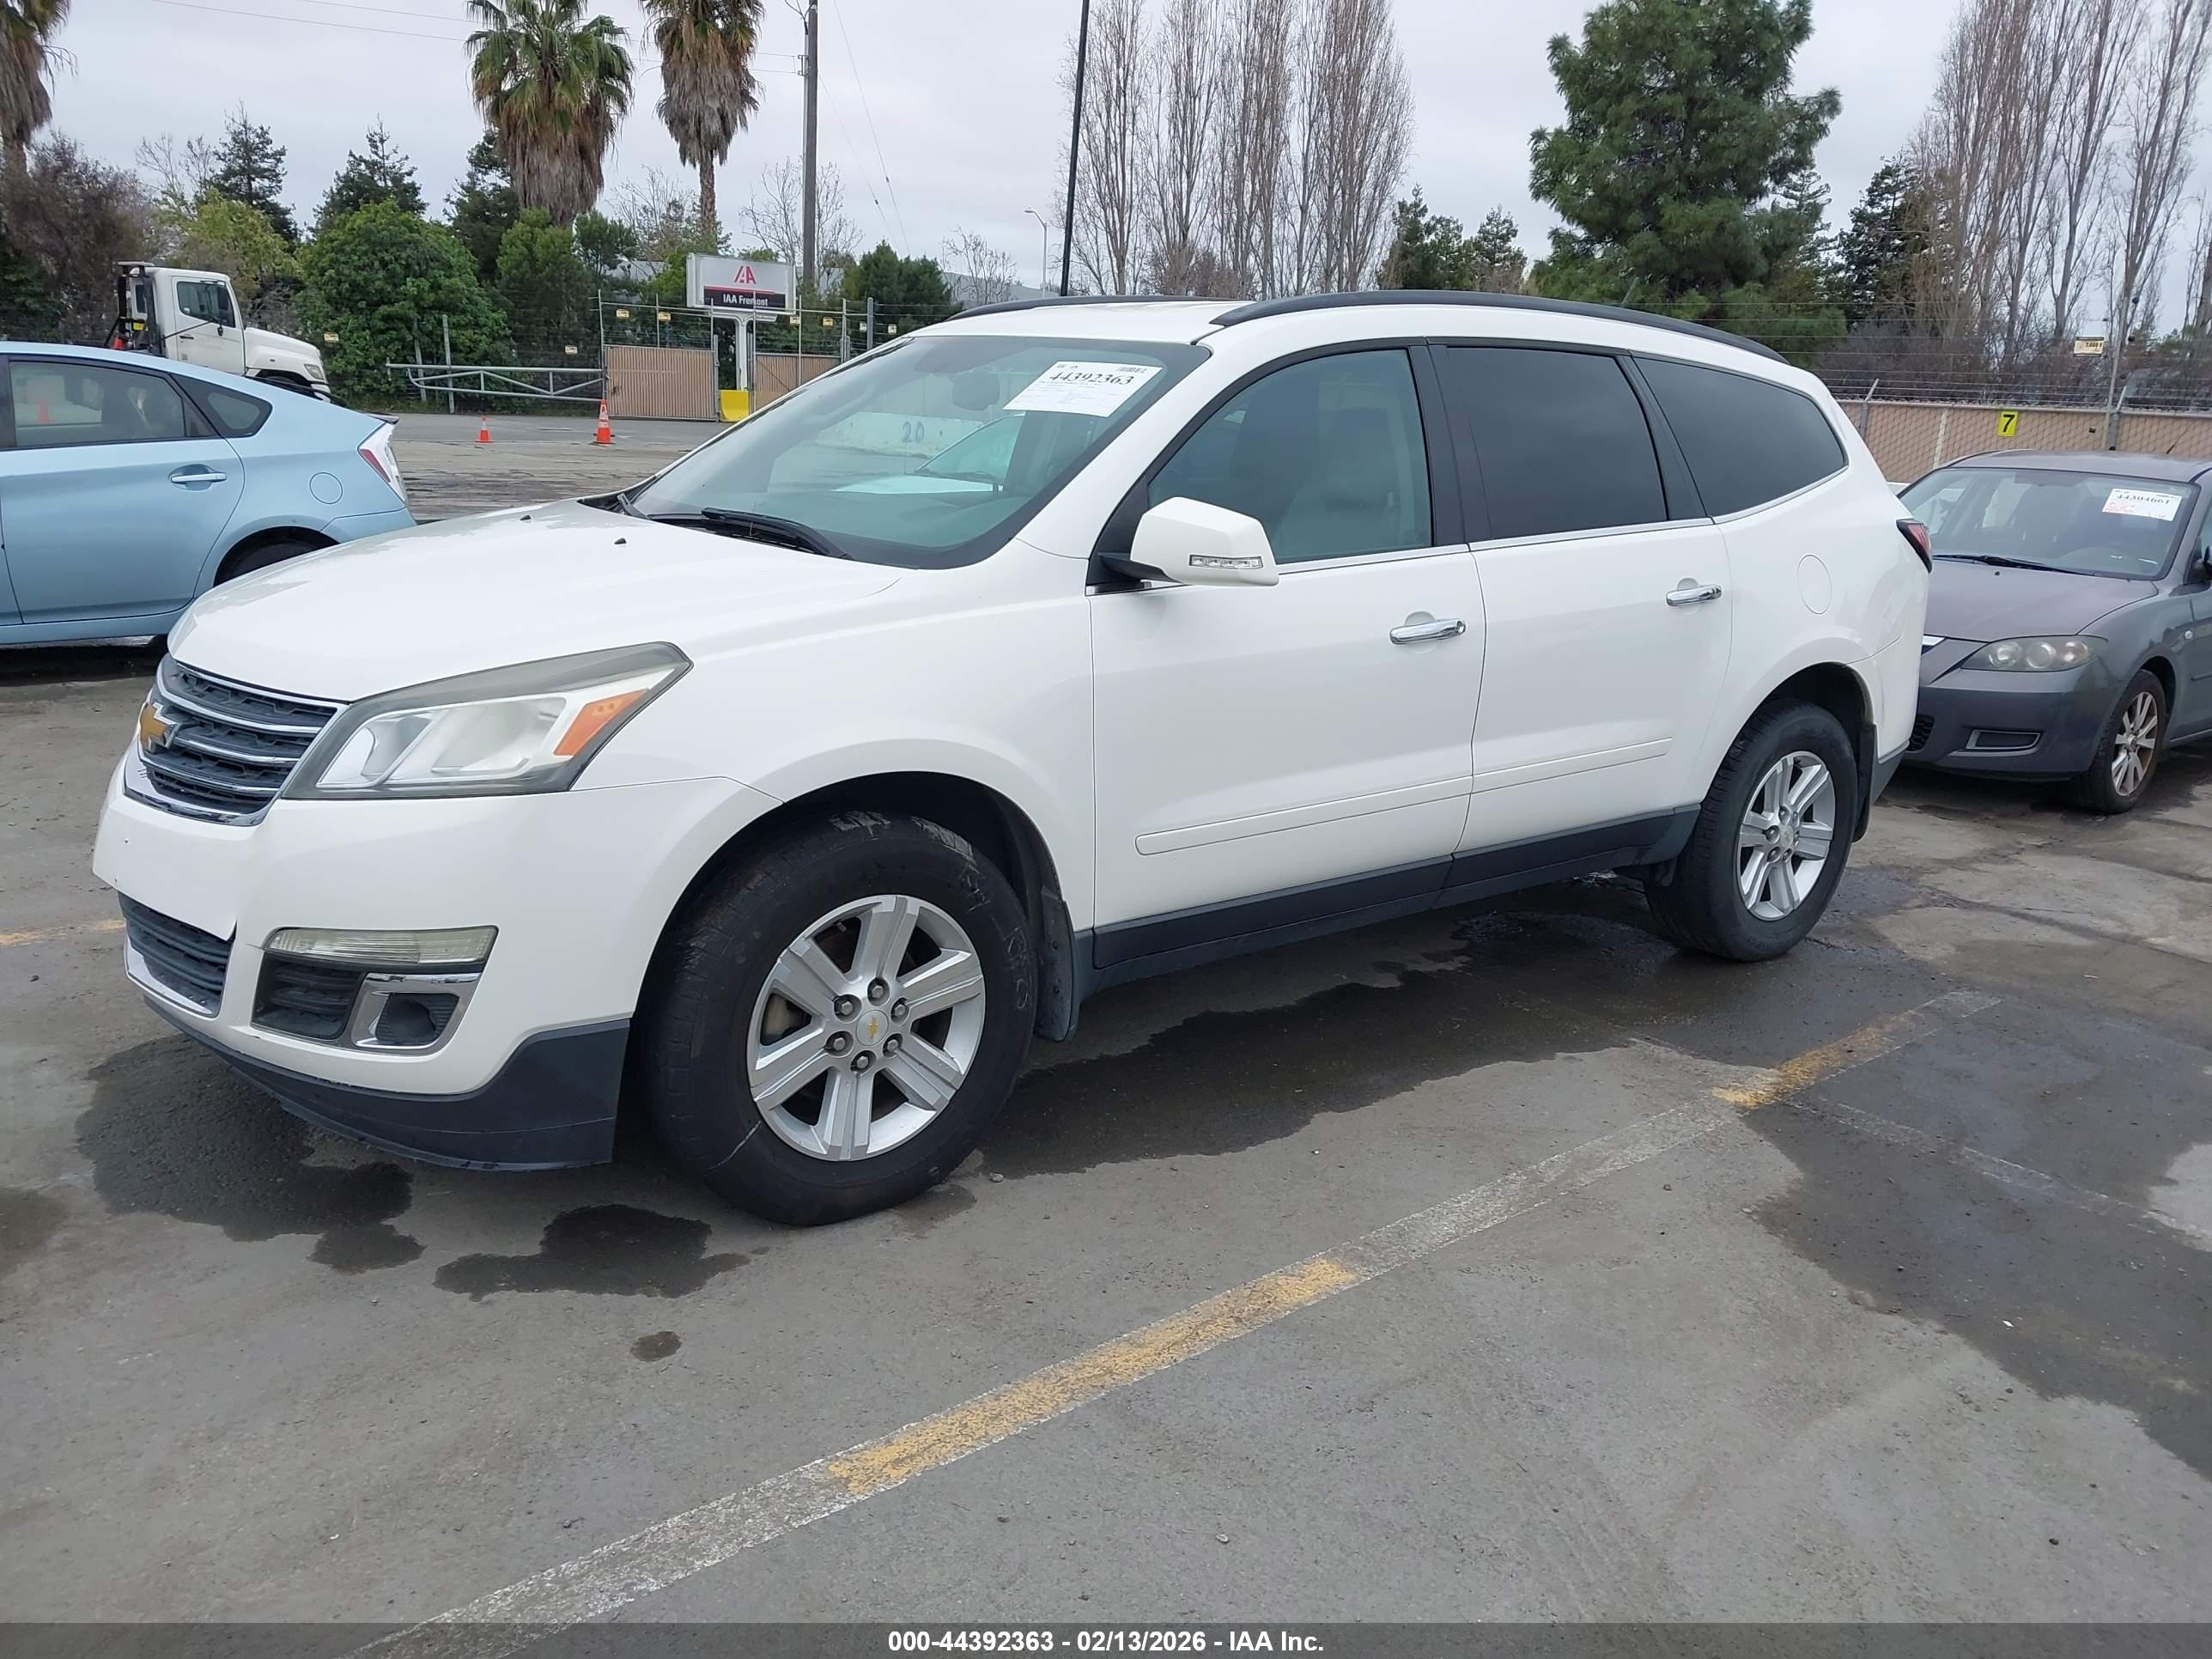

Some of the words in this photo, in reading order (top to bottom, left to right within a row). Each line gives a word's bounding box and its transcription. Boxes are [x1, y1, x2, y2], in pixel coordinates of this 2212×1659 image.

[722, 293, 738, 304] IAA
[738, 295, 769, 307] Fremont
[1049, 371, 1135, 386] 44392363
[2002, 413, 2015, 433] 7
[902, 421, 925, 443] 20
